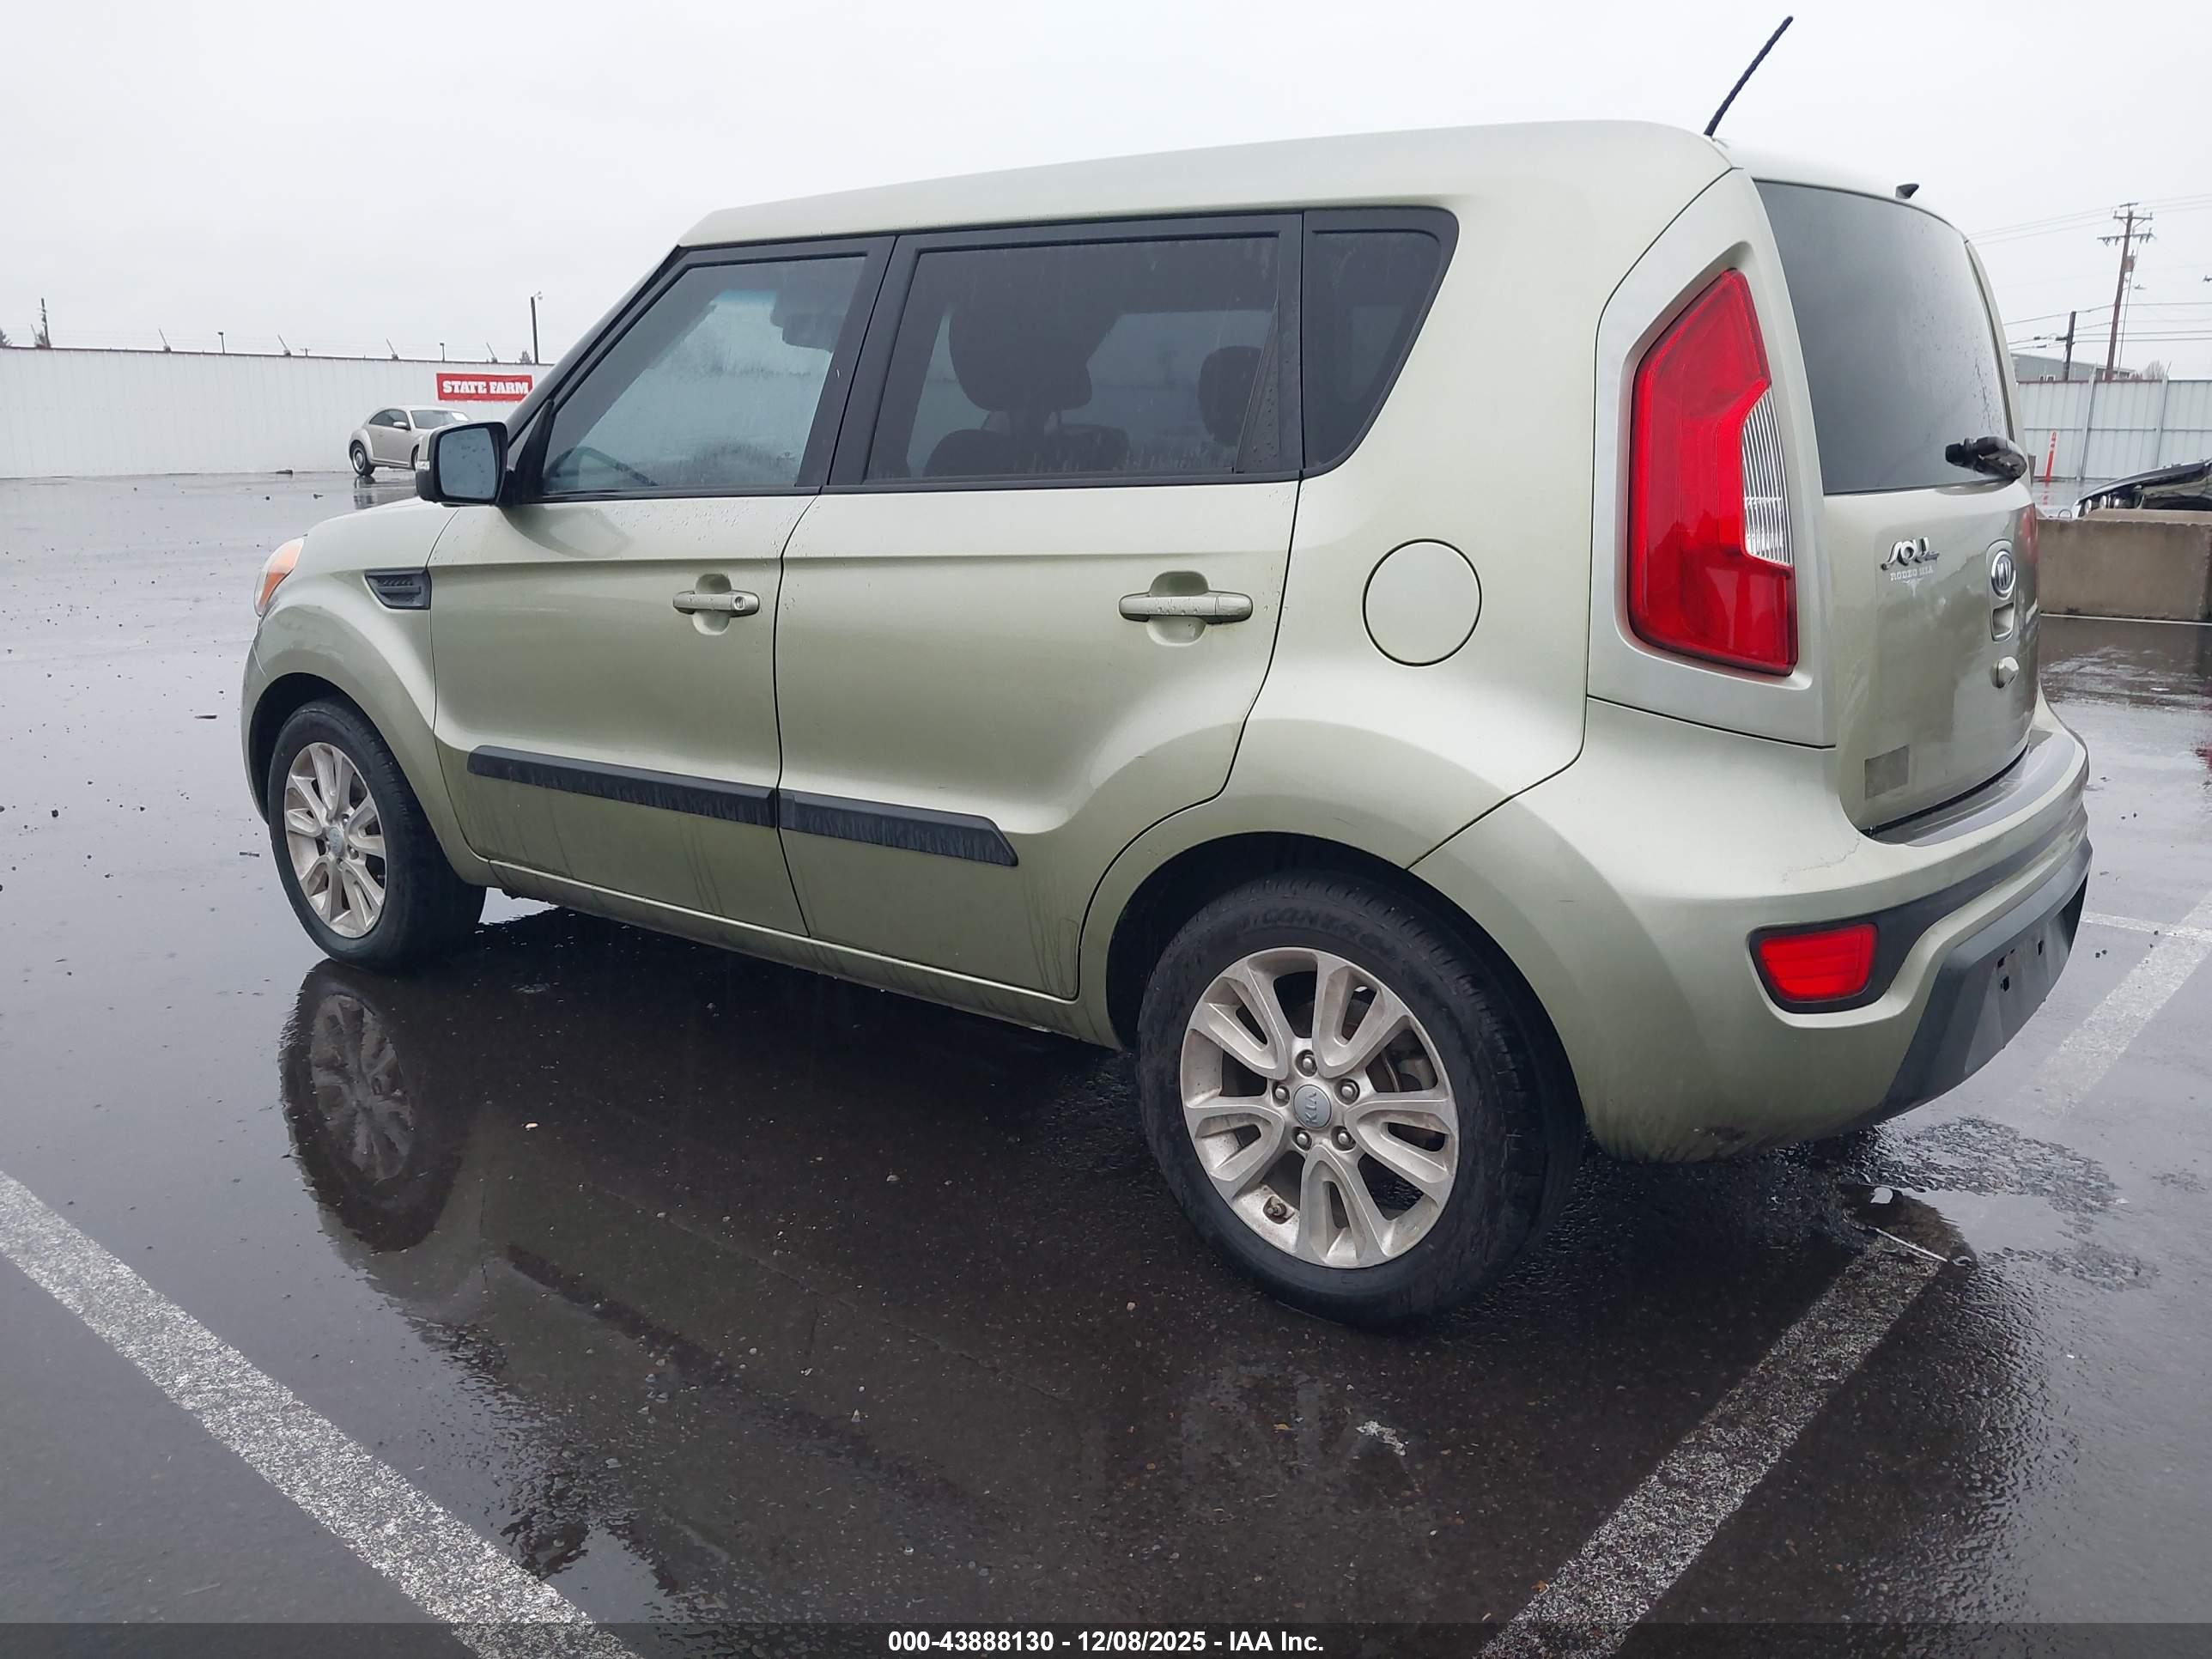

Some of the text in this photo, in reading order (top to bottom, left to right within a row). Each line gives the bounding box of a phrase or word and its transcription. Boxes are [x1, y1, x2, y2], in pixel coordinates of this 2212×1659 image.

[442, 380, 529, 395] STATE FARM
[1305, 1091, 1318, 1125] KIA
